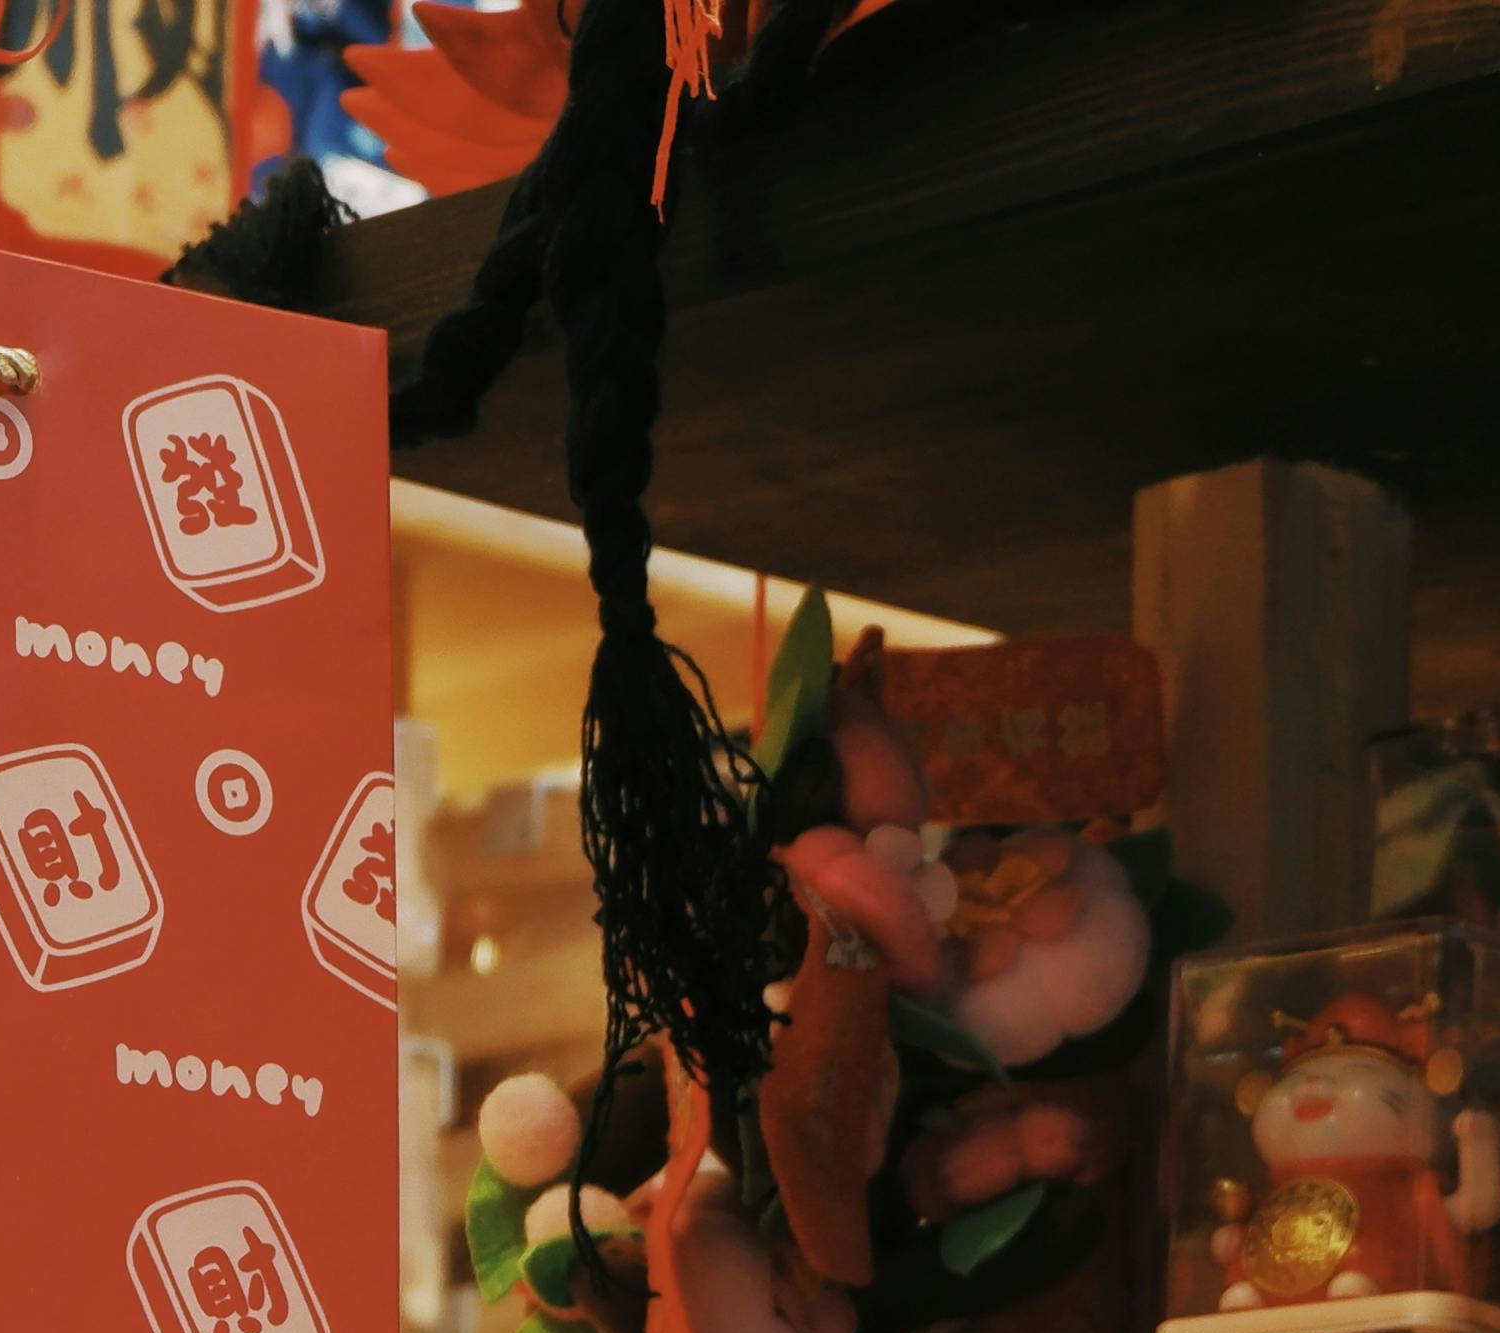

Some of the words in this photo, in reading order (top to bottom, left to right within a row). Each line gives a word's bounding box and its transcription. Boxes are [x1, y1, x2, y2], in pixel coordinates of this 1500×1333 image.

[160, 433, 257, 535] 發
[14, 615, 225, 698] money
[18, 790, 120, 907] 財
[115, 1042, 324, 1117] money
